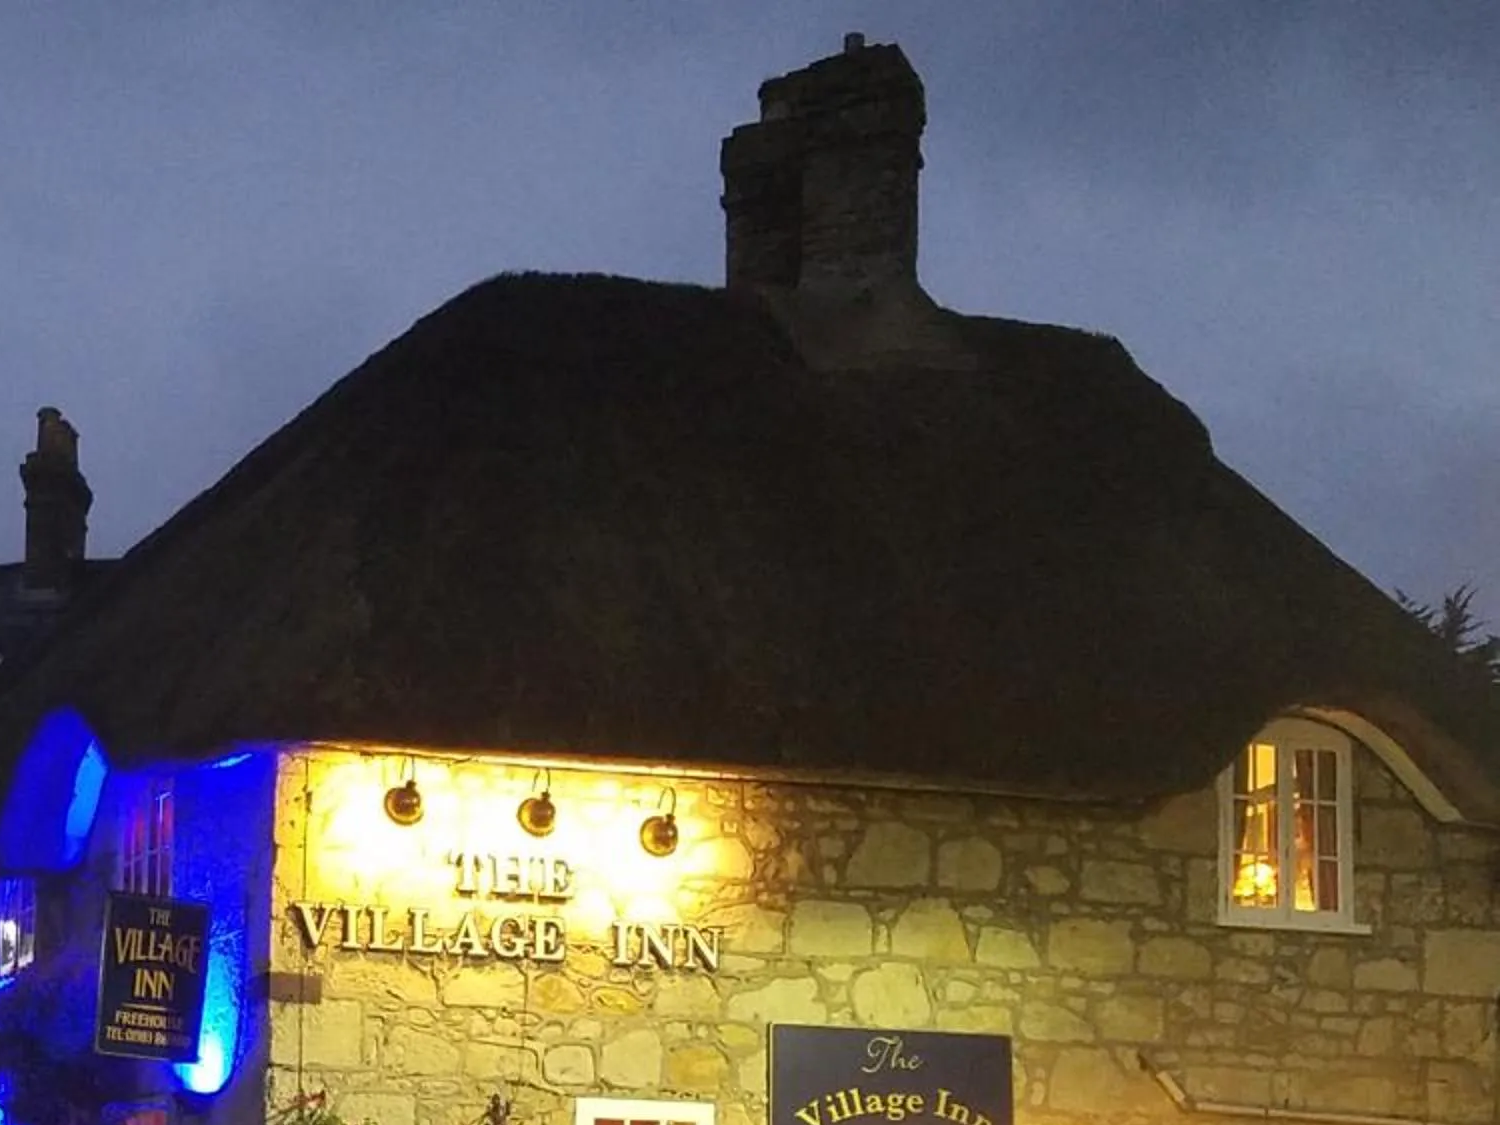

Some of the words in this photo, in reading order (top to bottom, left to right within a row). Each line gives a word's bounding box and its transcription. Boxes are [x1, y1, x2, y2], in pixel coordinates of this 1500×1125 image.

[451, 852, 575, 902] THE
[148, 908, 171, 926] THE
[293, 900, 567, 963] VILLAGE
[612, 919, 723, 970] INN
[115, 927, 200, 973] VILLAGE
[134, 968, 175, 1000] INN
[861, 1035, 924, 1074] The
